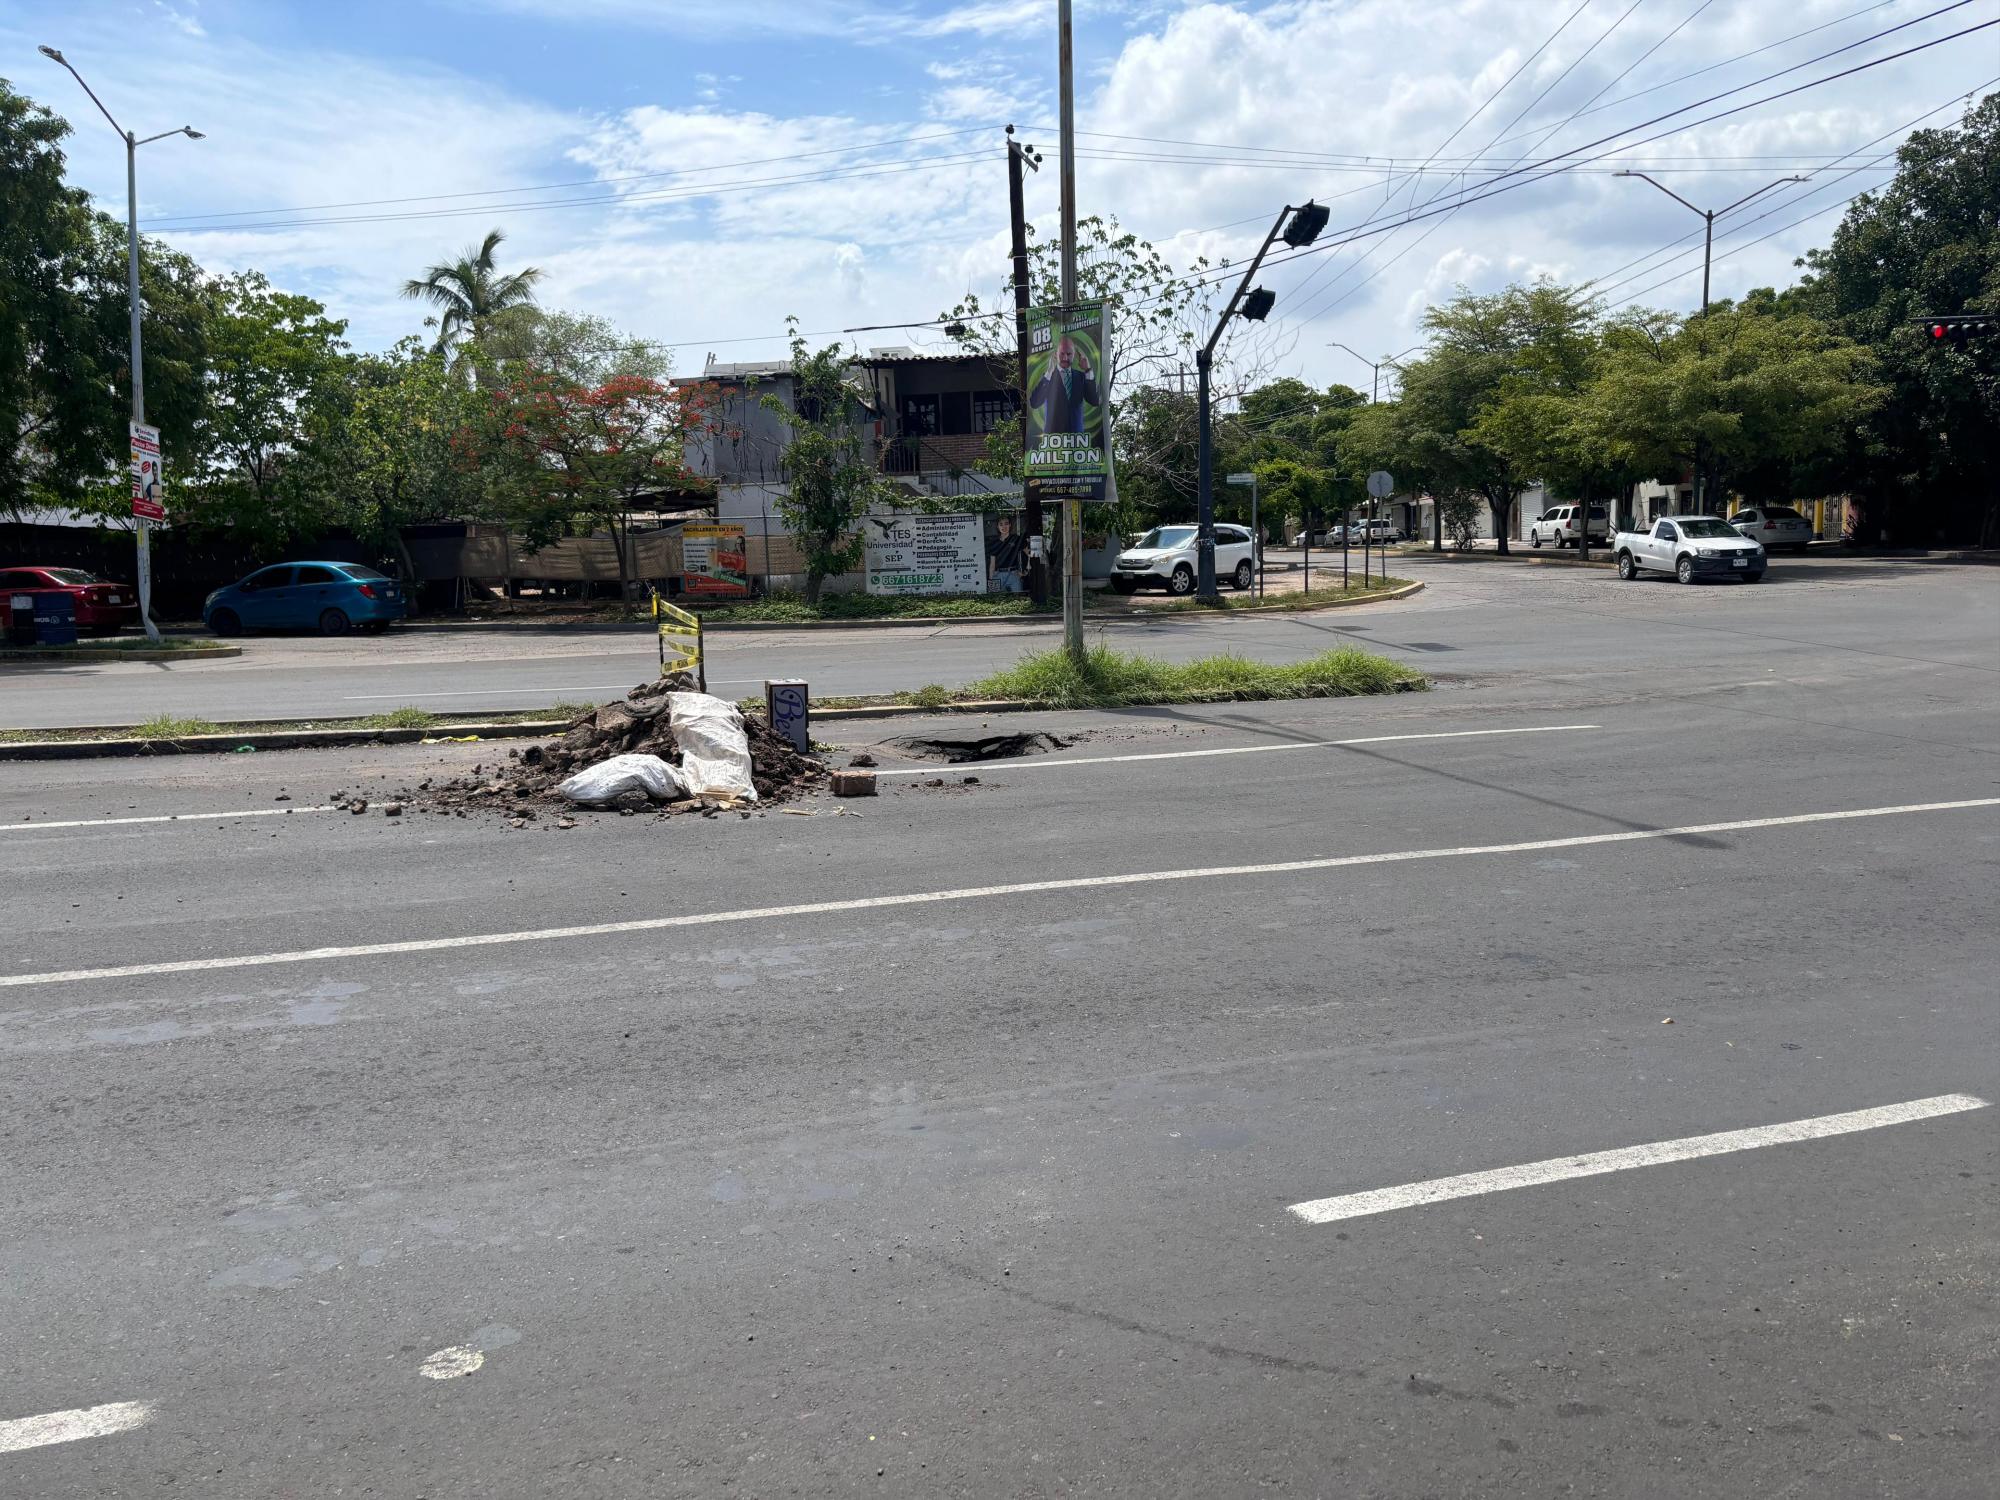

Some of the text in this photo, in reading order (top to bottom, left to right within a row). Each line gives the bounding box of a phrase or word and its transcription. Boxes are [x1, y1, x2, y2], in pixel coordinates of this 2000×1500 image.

[1033, 328, 1051, 345] 08
[1031, 342, 1054, 354] AGOSTO
[1040, 434, 1089, 449] JOHN
[1030, 449, 1100, 465] MILTON
[890, 529, 911, 539] TES
[867, 540, 913, 549] Universidad
[885, 554, 903, 563] SEP
[882, 574, 943, 584] 6671618723
